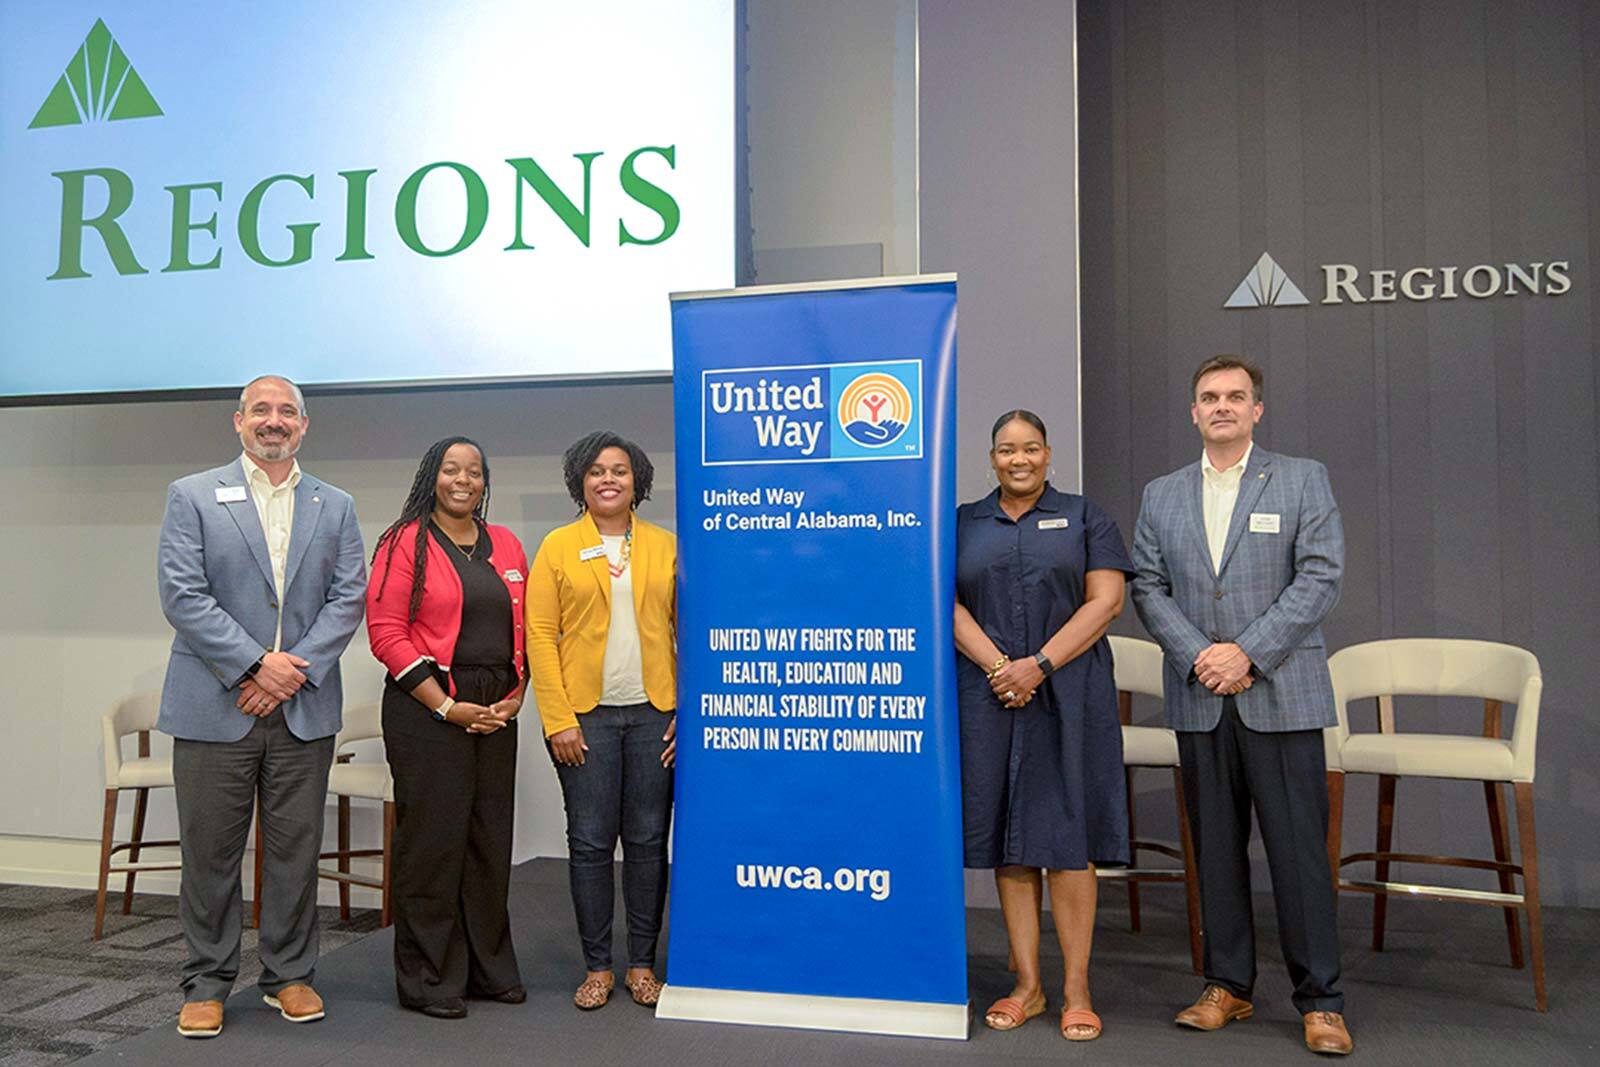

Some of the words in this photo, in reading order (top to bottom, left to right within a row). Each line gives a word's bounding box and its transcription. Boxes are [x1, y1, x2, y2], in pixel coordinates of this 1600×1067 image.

[46, 144, 681, 281] REGIONS
[1321, 260, 1572, 304] REGIONS
[710, 376, 824, 413] United
[753, 414, 823, 455] Way
[703, 488, 761, 507] United
[766, 488, 804, 508] Way
[703, 513, 722, 531] of
[726, 512, 791, 530] Central
[796, 511, 882, 530] Alabama,
[887, 510, 922, 527] Inc.
[709, 628, 760, 652] UNITED
[764, 628, 798, 651] WAY
[801, 628, 853, 651] FIGHTS
[857, 628, 884, 651] FOR
[888, 628, 916, 651] THE
[722, 661, 782, 687] HEALTH,
[785, 661, 867, 685] EDUCATION
[870, 662, 903, 685] AND
[701, 694, 777, 717] FINANCIAL
[780, 695, 854, 718] STABILITY
[857, 696, 876, 719] OF
[880, 696, 926, 719] EVERY
[704, 727, 760, 750] PERSON
[763, 728, 779, 750] IN
[783, 728, 829, 751] EVERY
[832, 730, 924, 753] COMMUNITY
[736, 864, 891, 901] uwca.org
